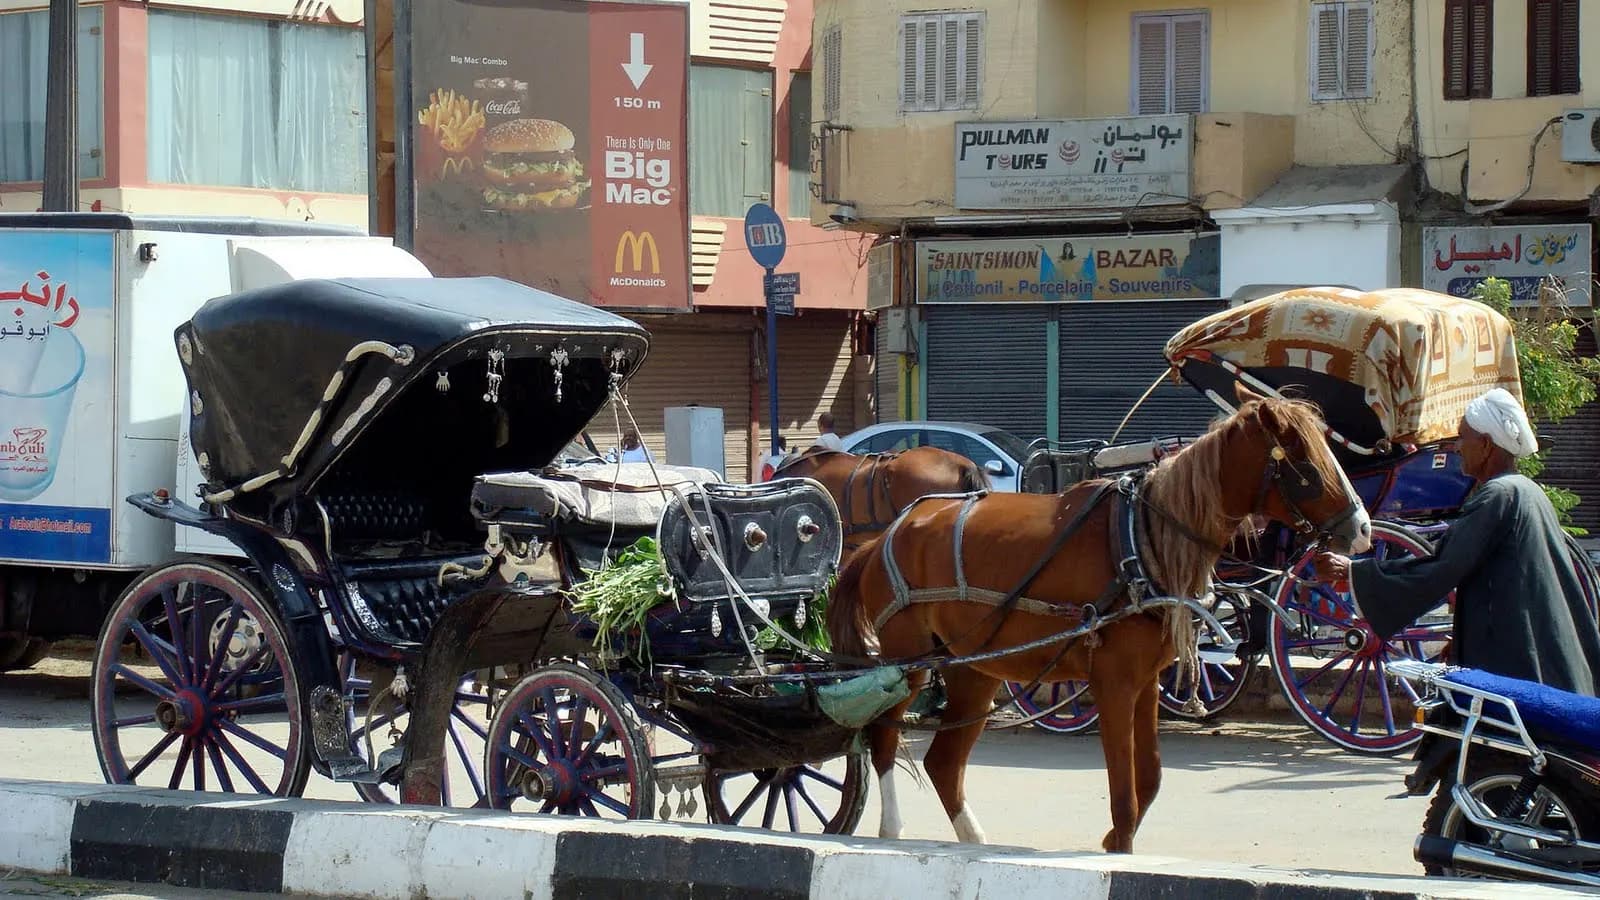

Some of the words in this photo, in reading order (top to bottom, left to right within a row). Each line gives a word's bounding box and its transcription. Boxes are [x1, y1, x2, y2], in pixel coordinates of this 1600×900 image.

[450, 55, 463, 64] Big
[482, 57, 508, 66] Combo
[614, 97, 643, 108] 150
[647, 100, 661, 109] m
[605, 136, 627, 148] There
[629, 137, 637, 149] Is
[638, 137, 655, 151] Only
[656, 138, 672, 150] One
[960, 128, 1049, 160] PULLMAN
[1103, 124, 1182, 149] بولمان
[605, 150, 671, 188] Big
[605, 182, 672, 206] Mac
[934, 250, 1040, 270] SAINTSIMON
[1096, 248, 1174, 268] BAZAR
[610, 277, 667, 288] McDonald's
[942, 280, 1003, 297] Cottonil
[1018, 279, 1093, 296] Porcelain
[1109, 278, 1192, 294] Souvenirs
